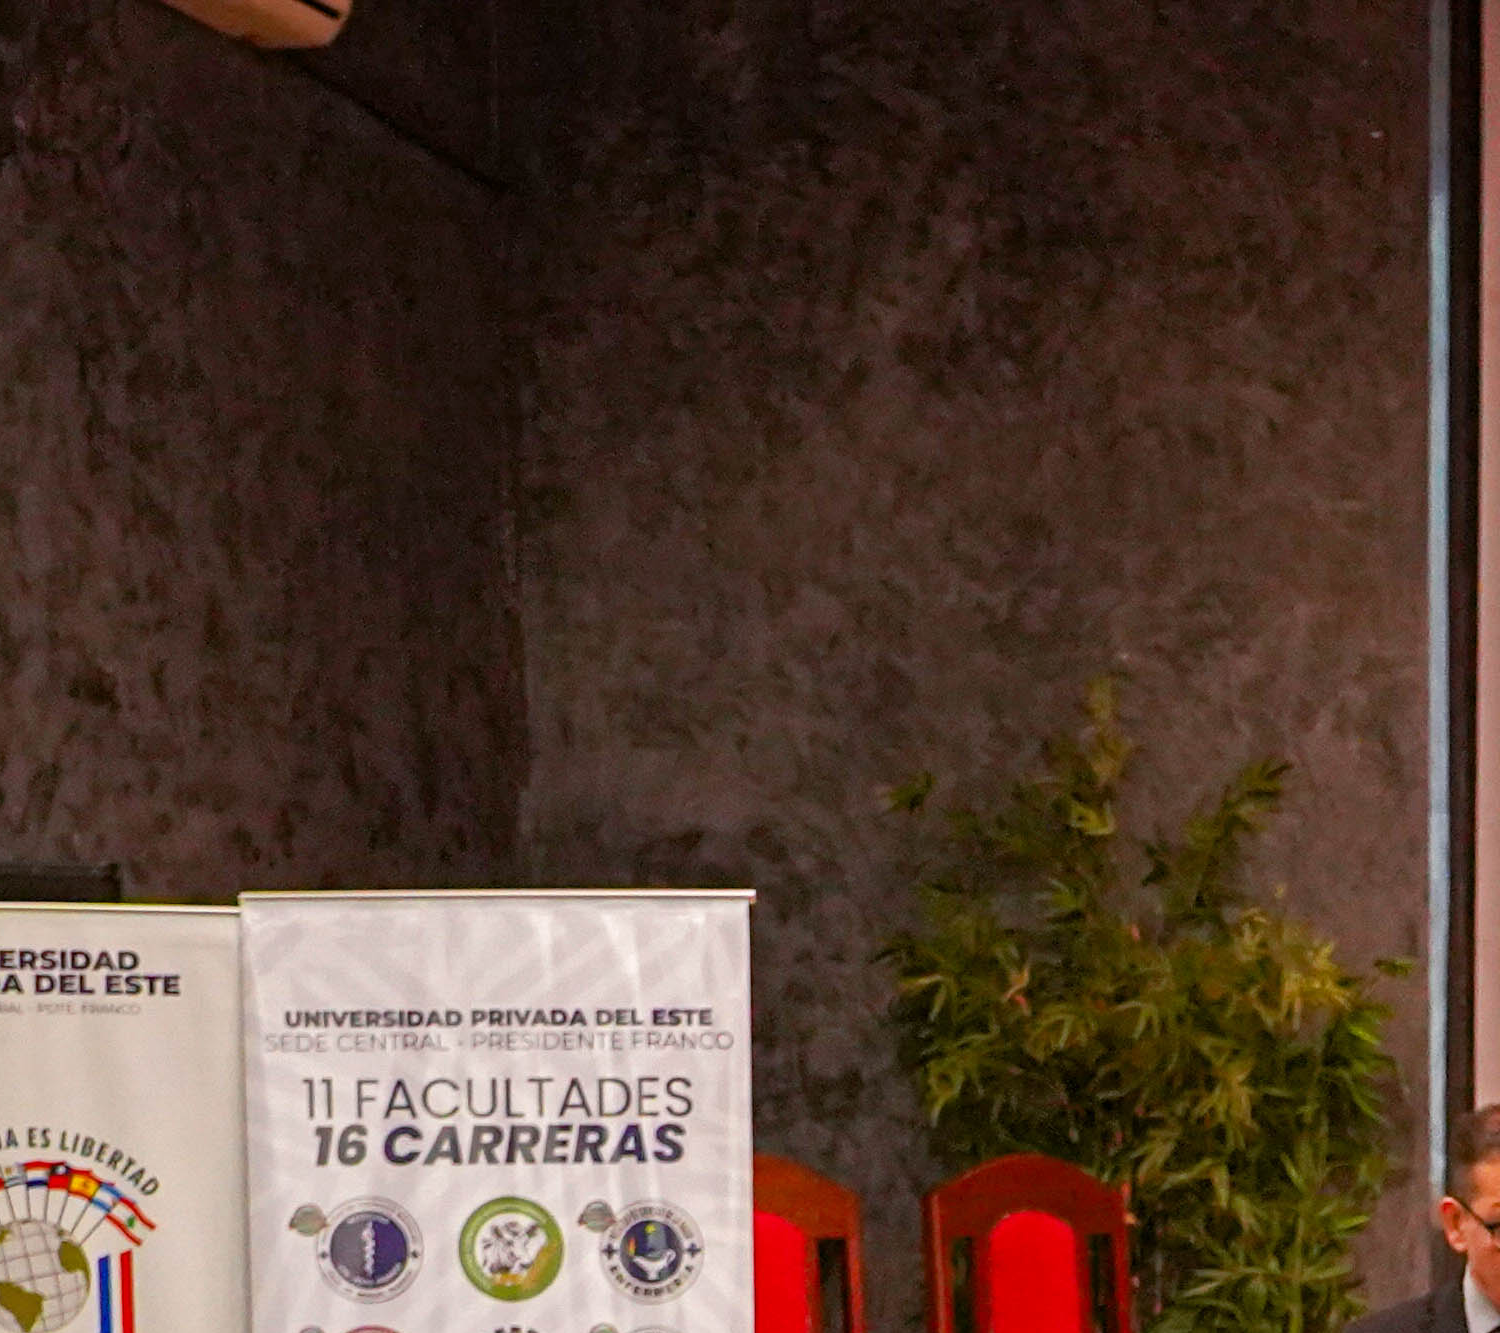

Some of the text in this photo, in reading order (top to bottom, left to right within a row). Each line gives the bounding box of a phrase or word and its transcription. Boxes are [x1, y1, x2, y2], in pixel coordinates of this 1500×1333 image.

[34, 974, 96, 995] DEL
[104, 974, 181, 996] ESTE
[285, 1008, 714, 1029] UNIVERSIDAD PRIVADA DEL ESTE
[265, 1032, 327, 1053] SEDE
[336, 1032, 448, 1052] CENTRAL
[471, 1031, 624, 1051] PRESIDENTE
[631, 1031, 735, 1051] FRANCO
[302, 1077, 694, 1119] 11 FACULTADES
[314, 1123, 687, 1166] 16 CARRERAS
[26, 1126, 51, 1149] ES
[58, 1129, 161, 1197] LIBERTAD
